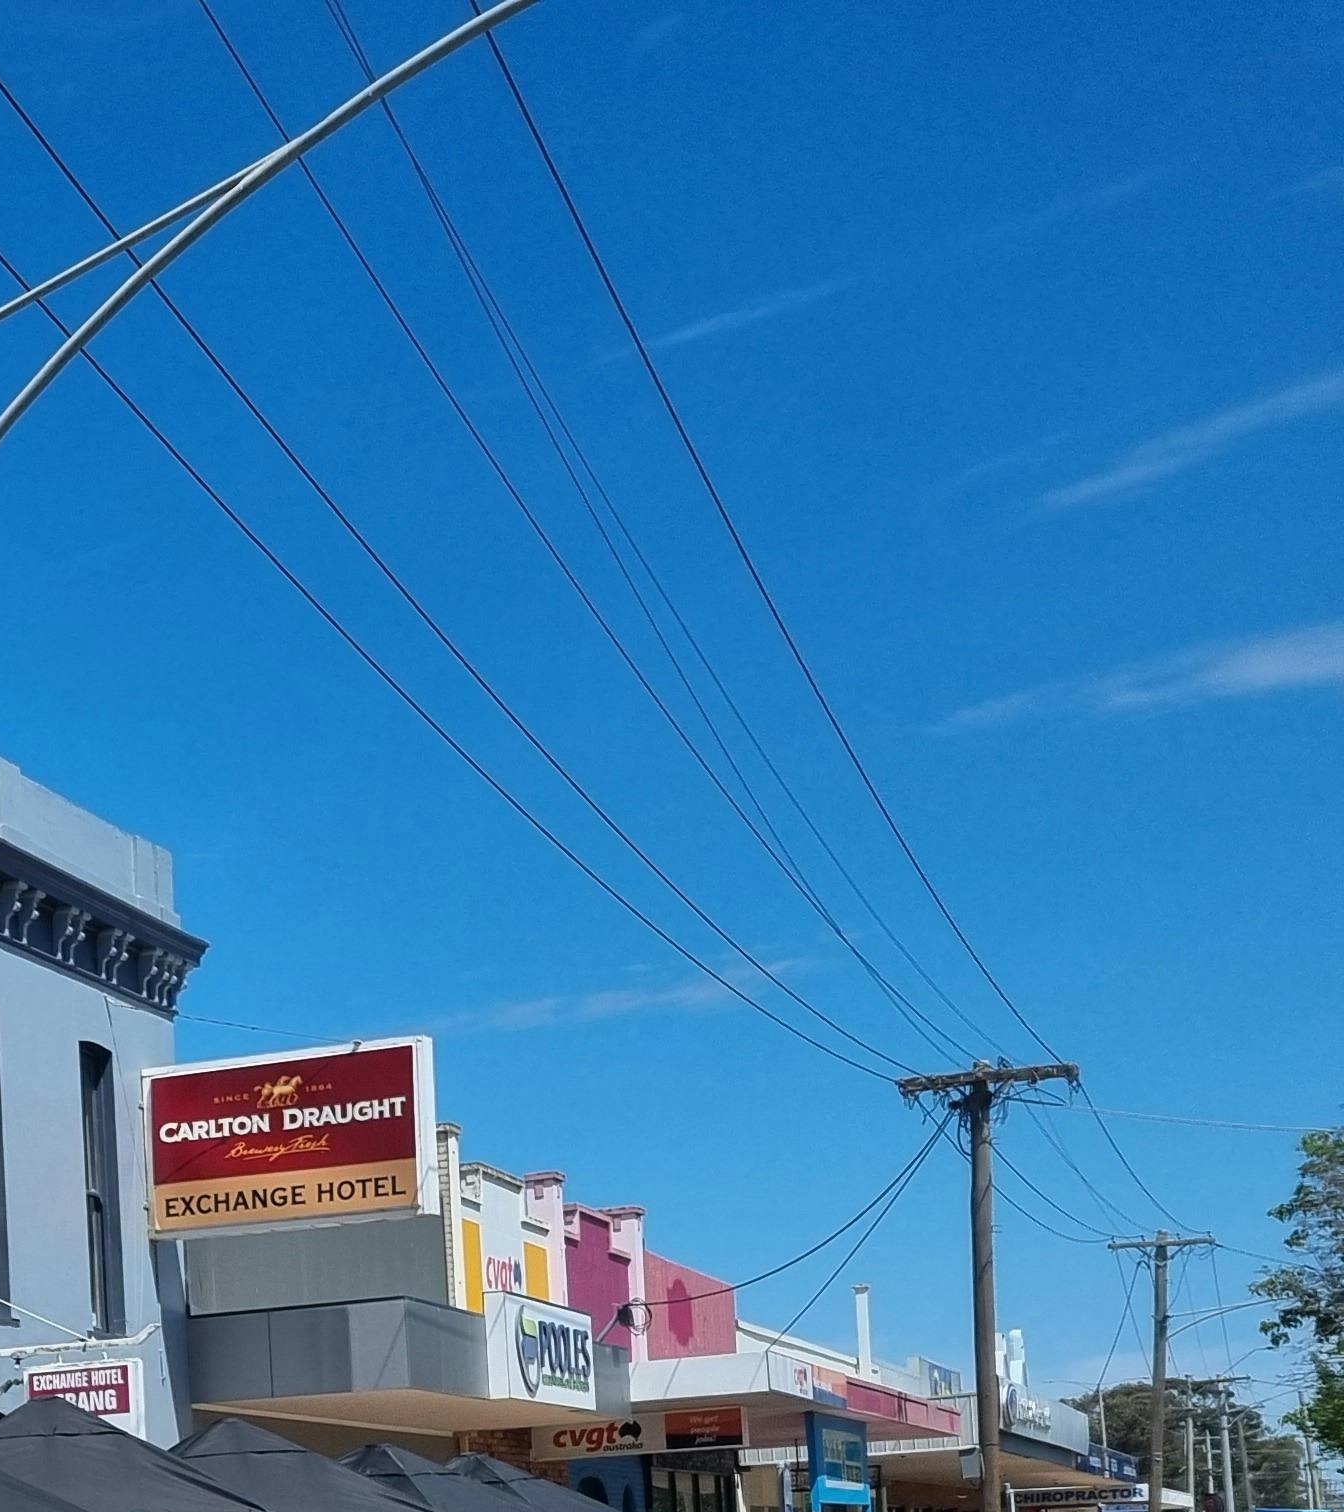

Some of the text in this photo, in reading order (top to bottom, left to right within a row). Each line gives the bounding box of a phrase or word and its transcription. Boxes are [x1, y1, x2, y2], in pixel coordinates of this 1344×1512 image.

[214, 1094, 250, 1104] SINCE
[159, 1096, 406, 1143] CARLTON DRAUGHT
[165, 1175, 406, 1218] EXCHANGE HOTEL
[538, 1321, 591, 1378] POOLES
[33, 1369, 124, 1391] EXCHANGE HOTEL
[55, 1389, 118, 1412] RANG
[553, 1421, 618, 1452] cvgt
[603, 1442, 643, 1452] australia
[1015, 1487, 1144, 1504] CHIROPRACTOR
